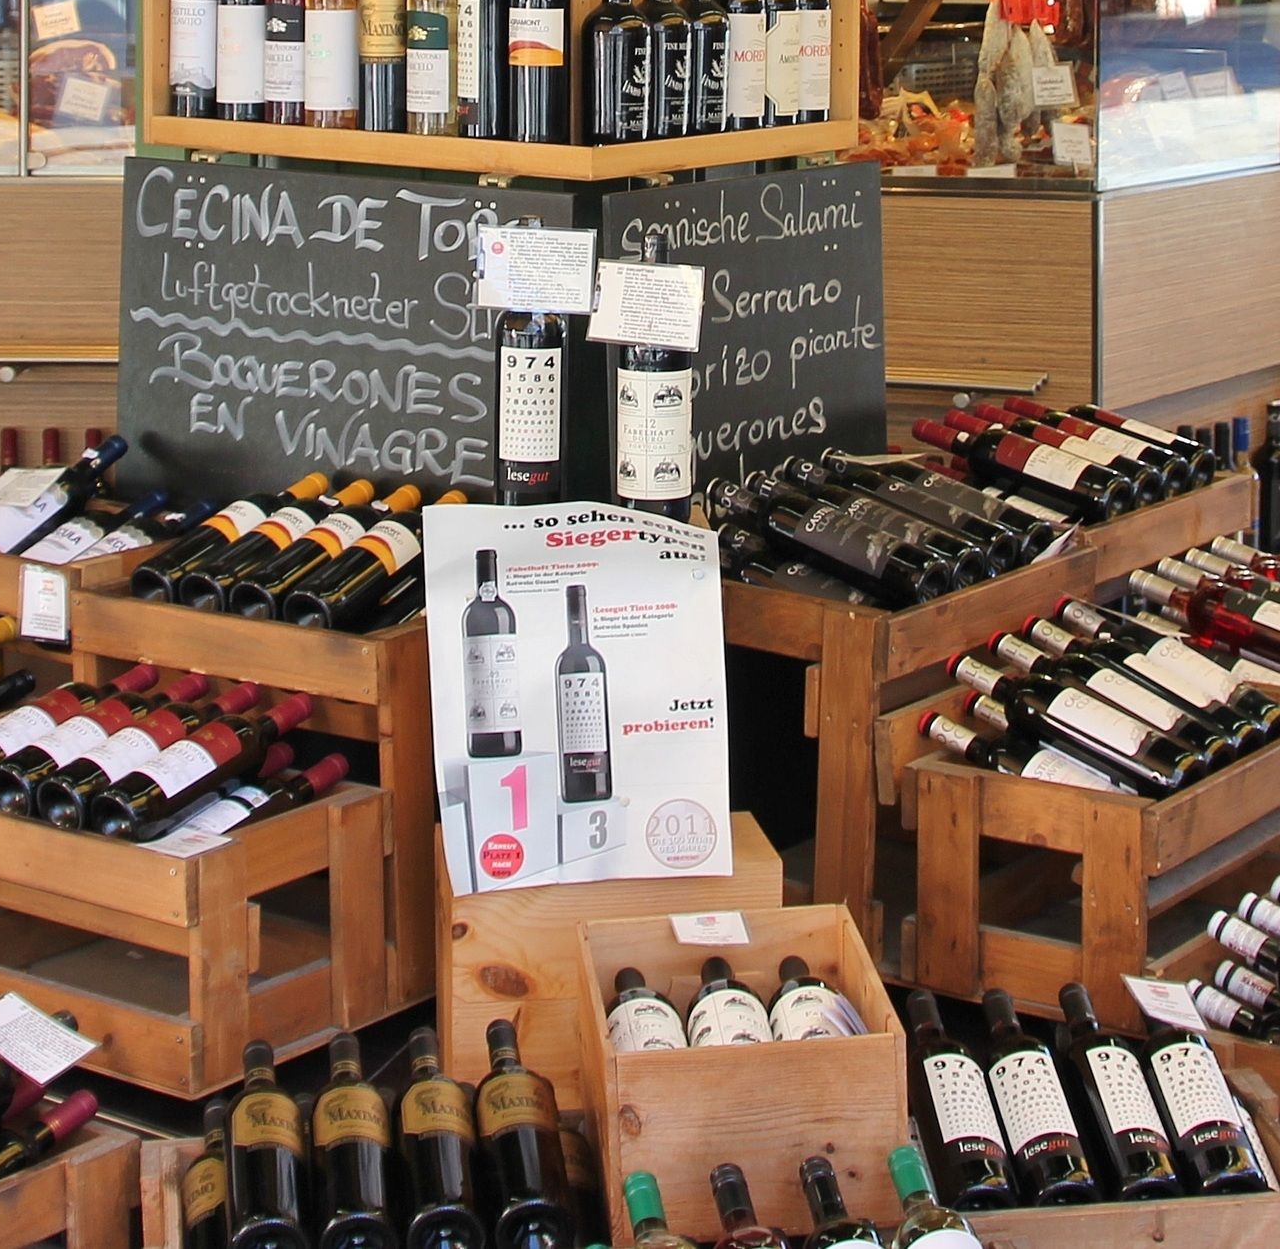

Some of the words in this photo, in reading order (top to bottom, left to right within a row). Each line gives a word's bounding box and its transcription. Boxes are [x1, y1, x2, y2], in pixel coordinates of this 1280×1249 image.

[137, 166, 304, 248] CECINA
[310, 195, 388, 251] DE
[755, 183, 863, 243] Salami
[711, 269, 842, 323] Serrano
[691, 345, 771, 396] orizo
[790, 295, 881, 389] picante
[148, 332, 488, 423] BOQUERONES
[190, 392, 253, 440] EN
[275, 408, 494, 486] VINAGRE
[507, 467, 550, 485] lesegut
[534, 517, 559, 529] so
[567, 510, 635, 526] sehen
[622, 716, 715, 735] probieren!
[669, 698, 714, 712] Jetzt
[500, 765, 528, 832] 1
[588, 810, 607, 849] 3
[647, 815, 716, 836] 2011
